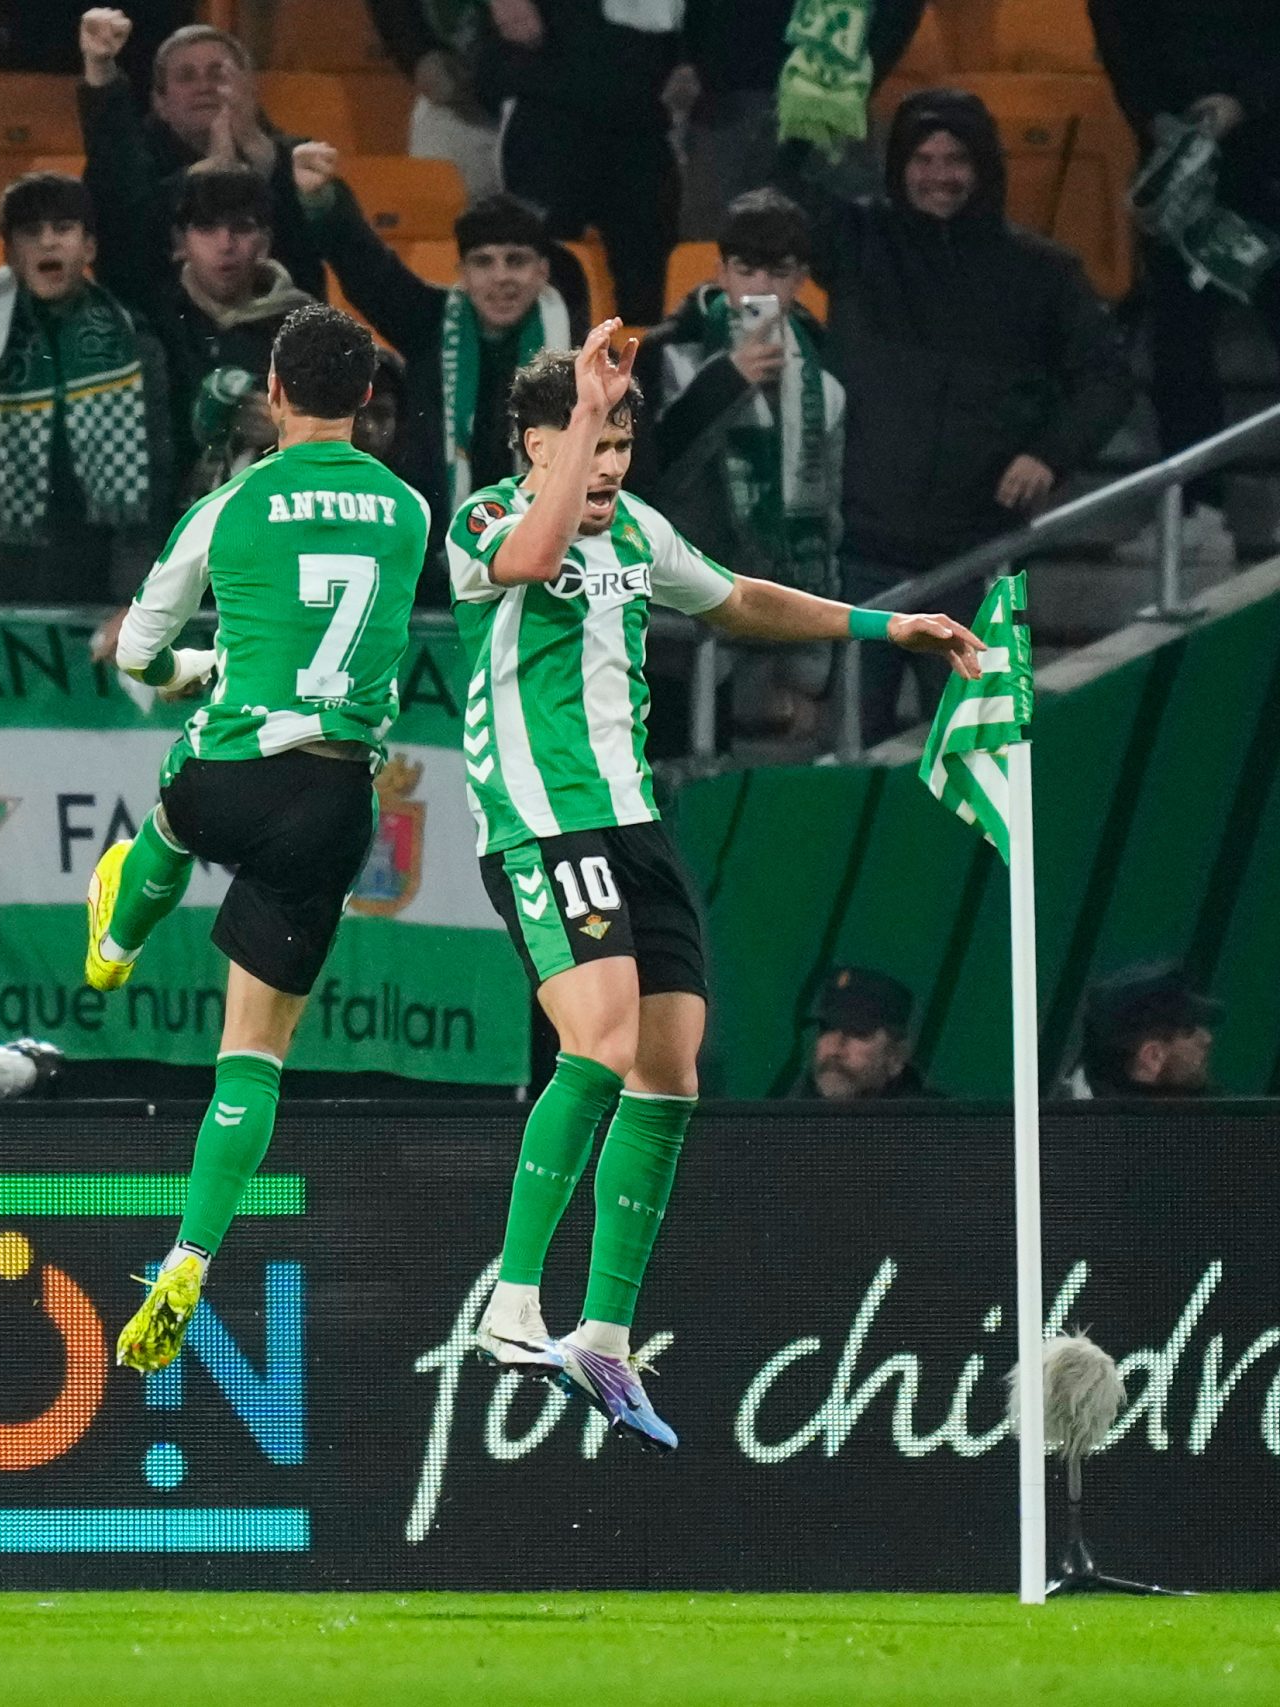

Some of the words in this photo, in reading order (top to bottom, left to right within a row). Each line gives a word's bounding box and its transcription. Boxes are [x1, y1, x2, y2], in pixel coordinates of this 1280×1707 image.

[268, 490, 397, 526] ANTONY
[296, 554, 380, 702] 7
[553, 855, 622, 920] 10
[318, 977, 477, 1053] fallan
